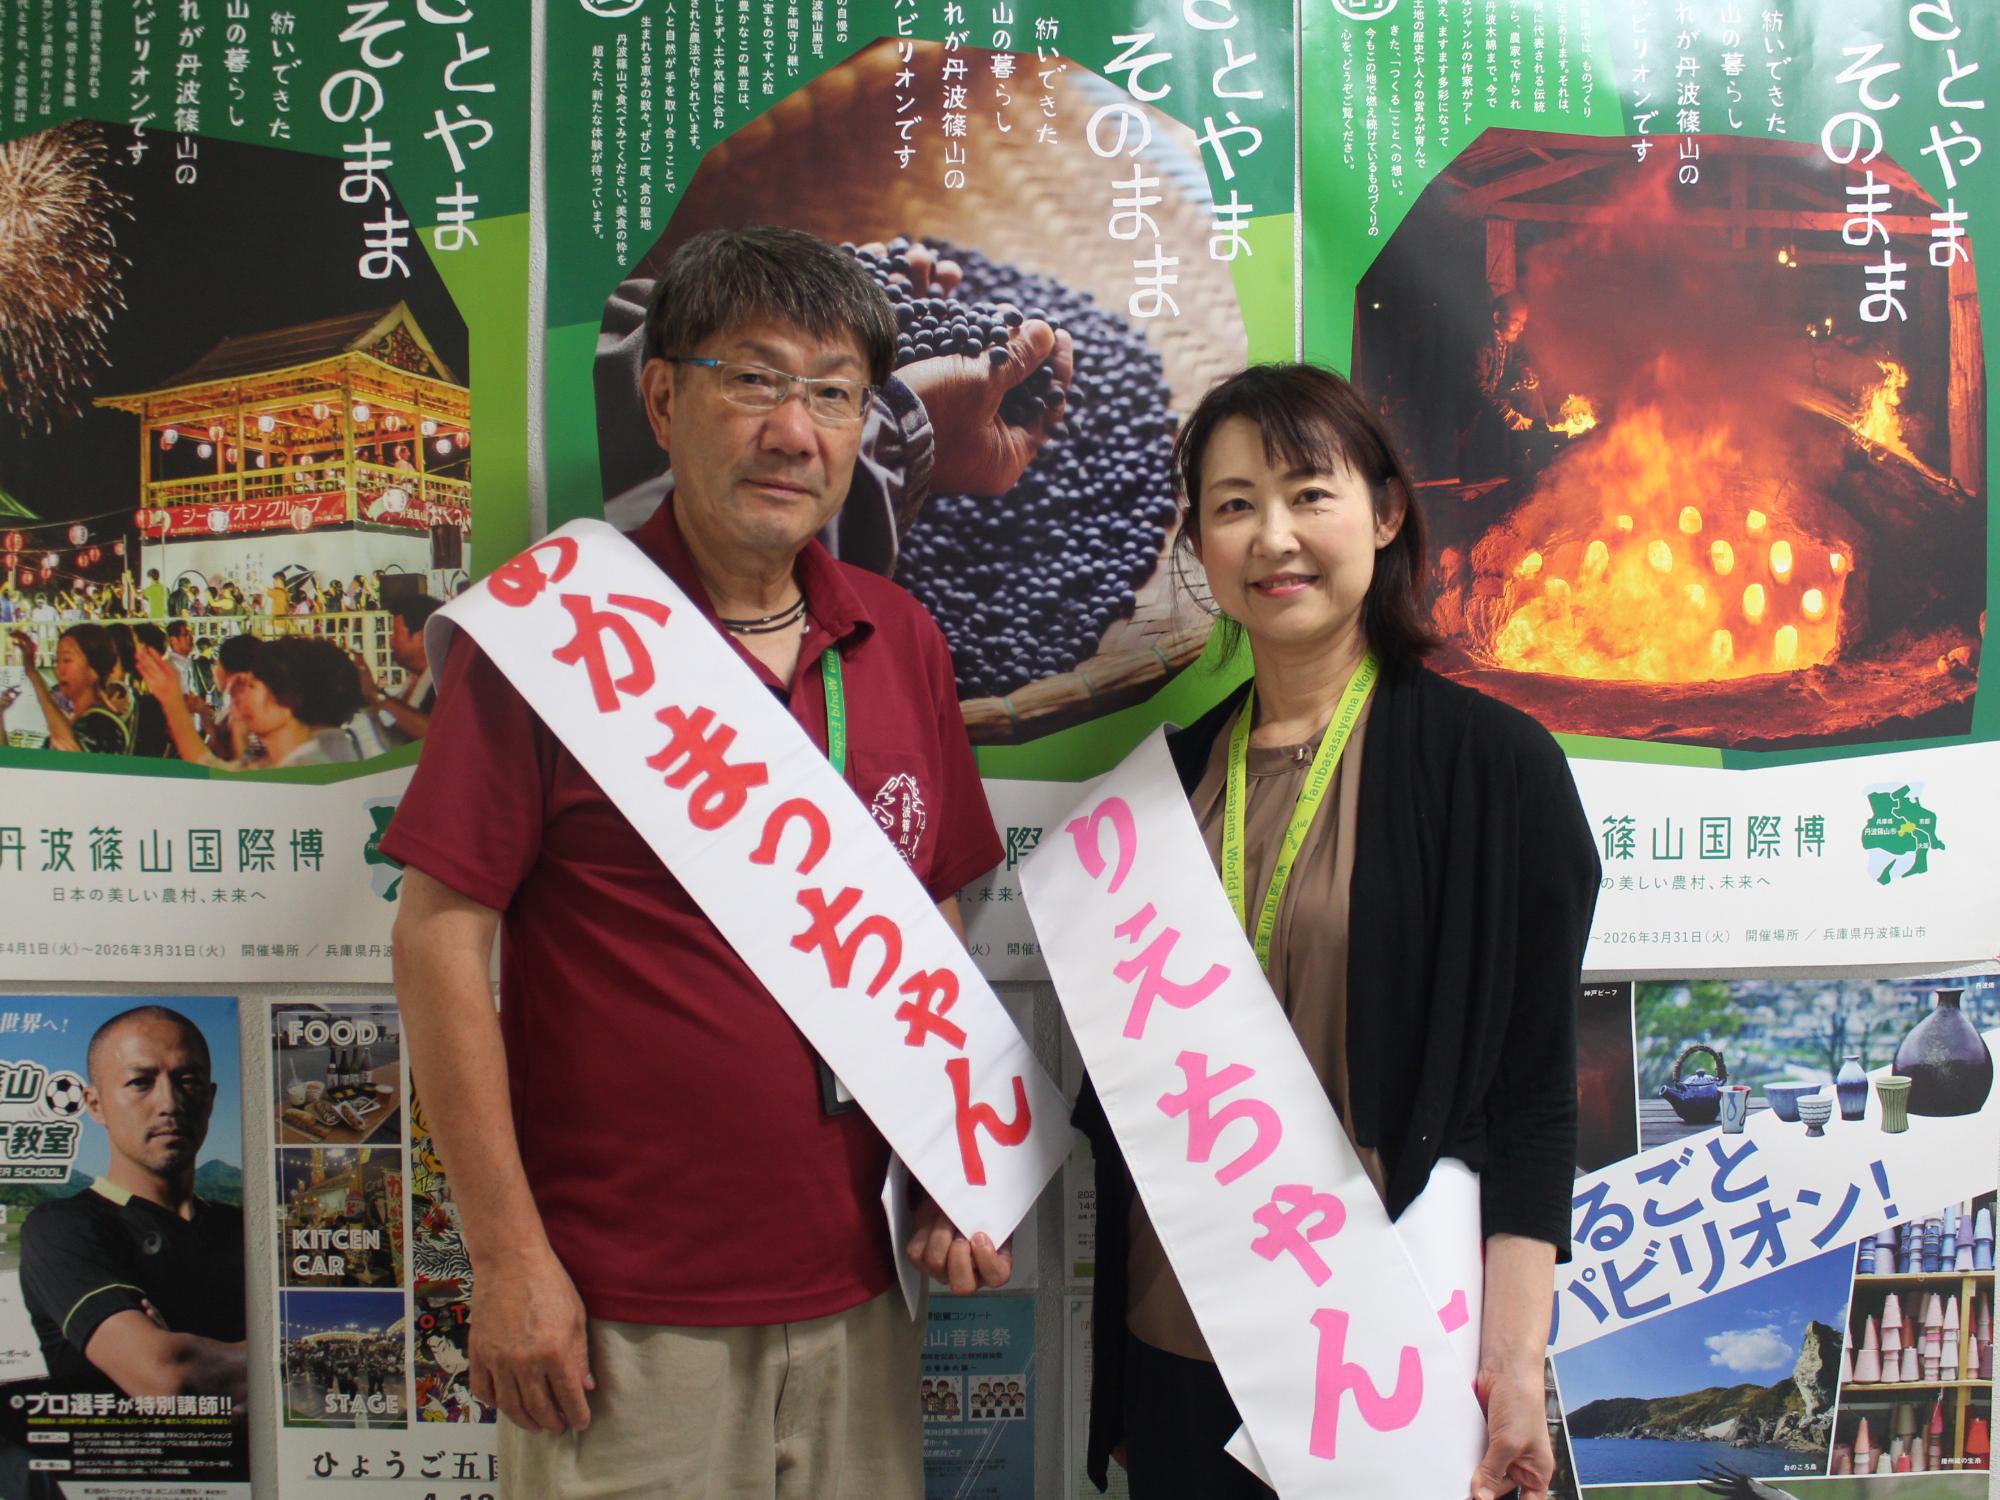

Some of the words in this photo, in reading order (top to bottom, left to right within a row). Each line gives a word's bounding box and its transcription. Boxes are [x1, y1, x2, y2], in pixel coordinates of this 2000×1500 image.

[126, 0, 156, 165] ビリオンです
[174, 0, 205, 184] れが丹波篠山の
[224, 0, 250, 127] 山の暮らし
[269, 11, 302, 139] 紡いできた
[664, 2, 677, 193] 人と自然が手を取り合うことで
[713, 0, 726, 130] しまず、土や気候に合わ
[762, 0, 774, 95] 宝ものです。大粒
[942, 1, 970, 189] れが丹波篠山の
[990, 2, 1016, 132] 山の暮らし
[1035, 17, 1067, 145] 紡いできた
[1675, 1, 1701, 184] れが丹波篠山の
[1720, 0, 1746, 129] 山の暮らし
[1761, 10, 1791, 133] 紡いできた
[319, 2, 411, 280] そのまま
[1087, 32, 1180, 318] そのまま
[1821, 44, 1907, 322] そのまま
[0, 826, 325, 873] 丹波篠山国際博
[899, 793, 911, 845] 丹波篠山
[1225, 845, 1239, 891] World
[1602, 814, 1825, 860] 篠山国際博
[52, 887, 267, 904] 日本の美しい農村、未来へ
[1745, 928, 1799, 942] 開催場所
[1823, 925, 1927, 942] 兵庫県丹波篠山市
[242, 944, 299, 958] 開催場所
[1584, 989, 1617, 997] 神戸ビーフ
[0, 1067, 39, 1099] 山
[287, 1020, 378, 1046] FOOD
[14, 1168, 64, 1177] SCHOOL
[1065, 796, 1424, 1460] りえちゃん
[292, 1229, 380, 1250] KITCEN
[1077, 1190, 1096, 1199] 202
[1572, 1137, 1769, 1252] るごと
[293, 1256, 345, 1276] CAR
[923, 1327, 1010, 1346] 山音楽祭
[325, 1394, 398, 1414] STAGE
